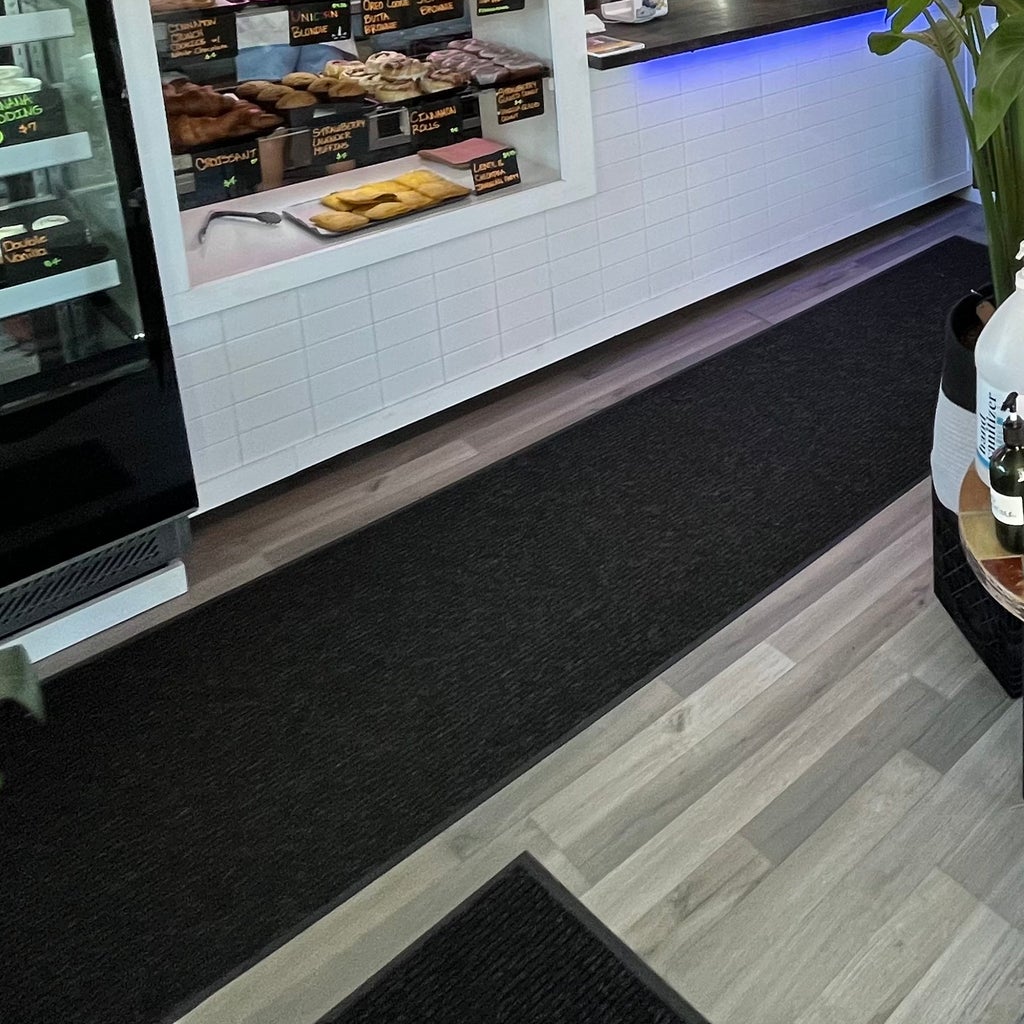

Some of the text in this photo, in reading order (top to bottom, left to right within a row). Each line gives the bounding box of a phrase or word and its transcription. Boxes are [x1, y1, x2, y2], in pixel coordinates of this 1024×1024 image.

[289, 9, 339, 23] UNICRN
[290, 24, 329, 39] BLONDIE
[0, 93, 34, 111] NANA
[0, 104, 44, 125] DDING
[411, 121, 441, 136] ROLLS
[195, 148, 257, 171] CROISSANT
[2, 235, 49, 253] Double
[4, 247, 48, 264] Vanilla
[979, 412, 987, 456] hand
